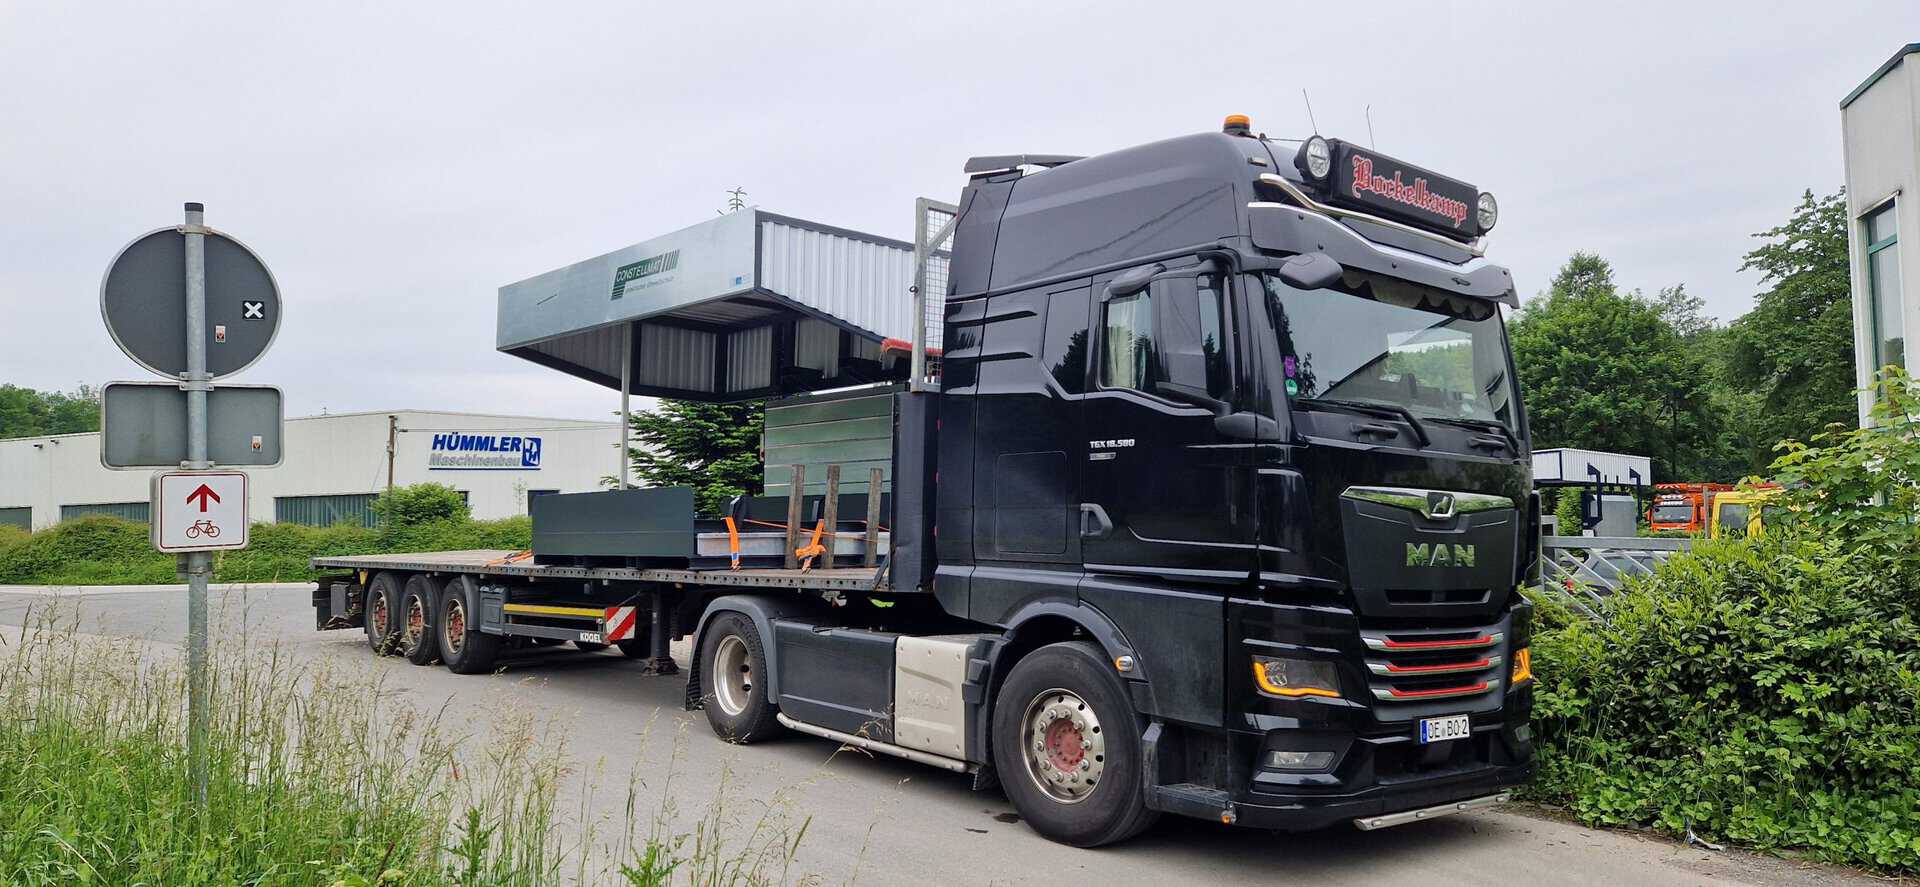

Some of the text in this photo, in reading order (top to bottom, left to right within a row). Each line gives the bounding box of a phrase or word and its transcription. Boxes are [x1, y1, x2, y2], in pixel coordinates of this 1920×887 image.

[1352, 155, 1467, 228] Bockelkamp
[432, 432, 522, 452] HÜMMLER
[1089, 440, 1106, 449] TGX
[429, 453, 521, 467] Maschinenbau
[1406, 543, 1475, 567] MAN
